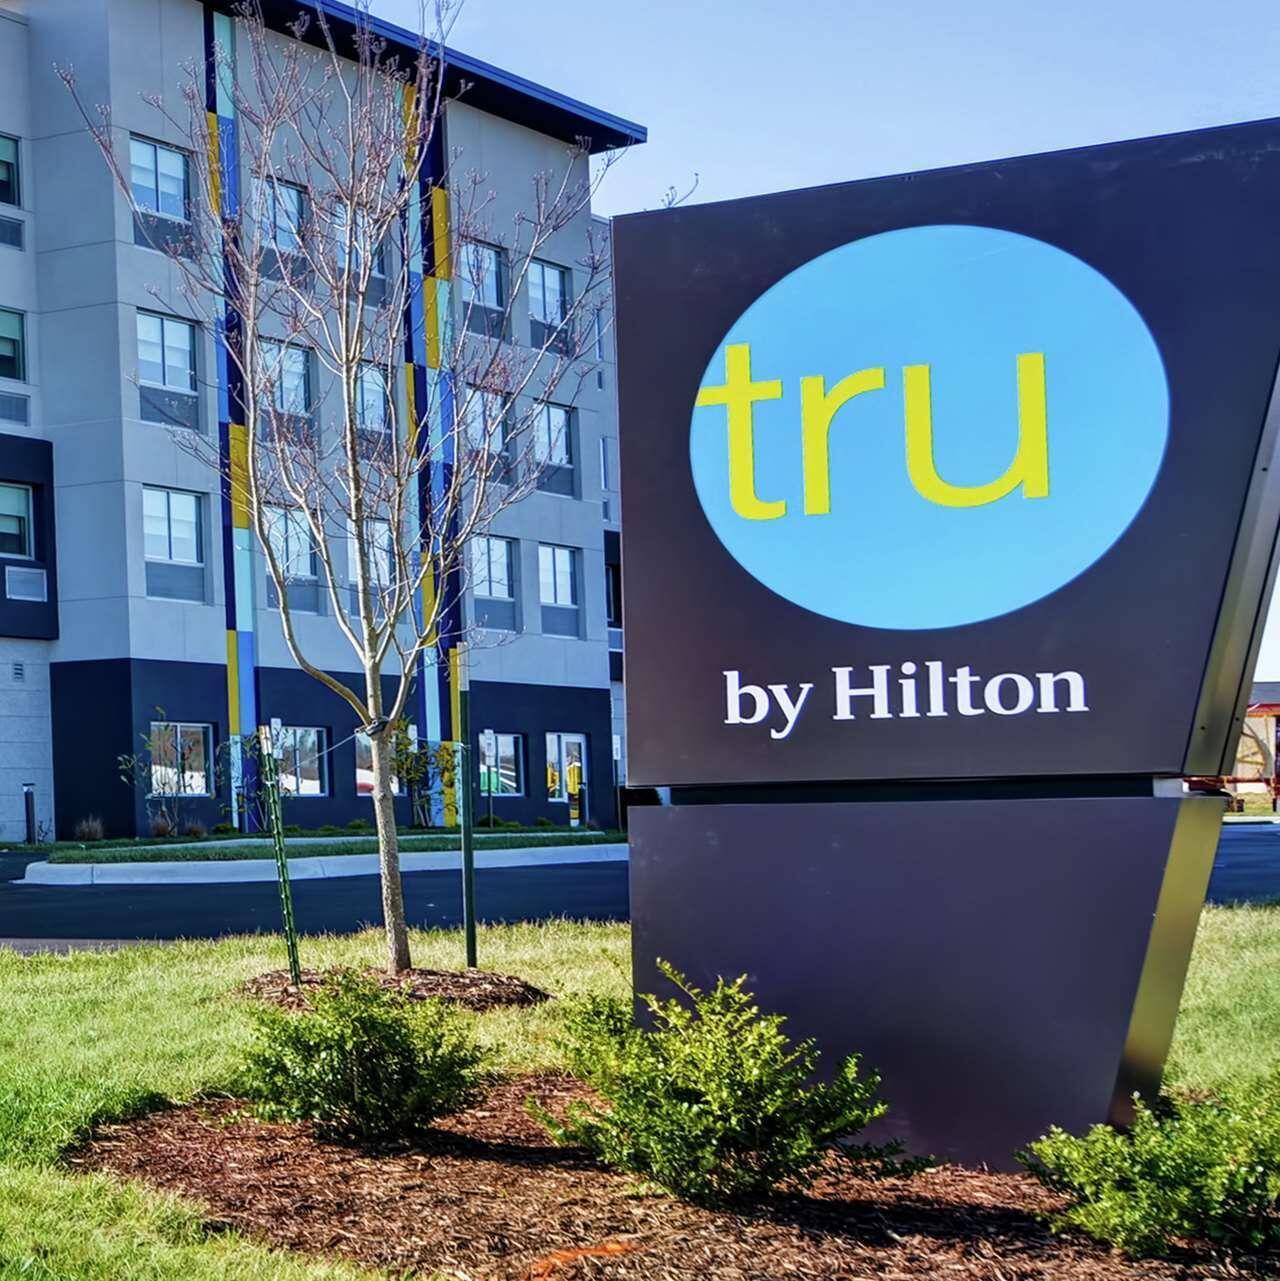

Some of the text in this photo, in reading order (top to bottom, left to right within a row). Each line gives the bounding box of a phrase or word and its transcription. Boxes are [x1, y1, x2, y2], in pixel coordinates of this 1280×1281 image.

[695, 342, 1050, 520] tru
[723, 661, 1090, 740] by Hilton
